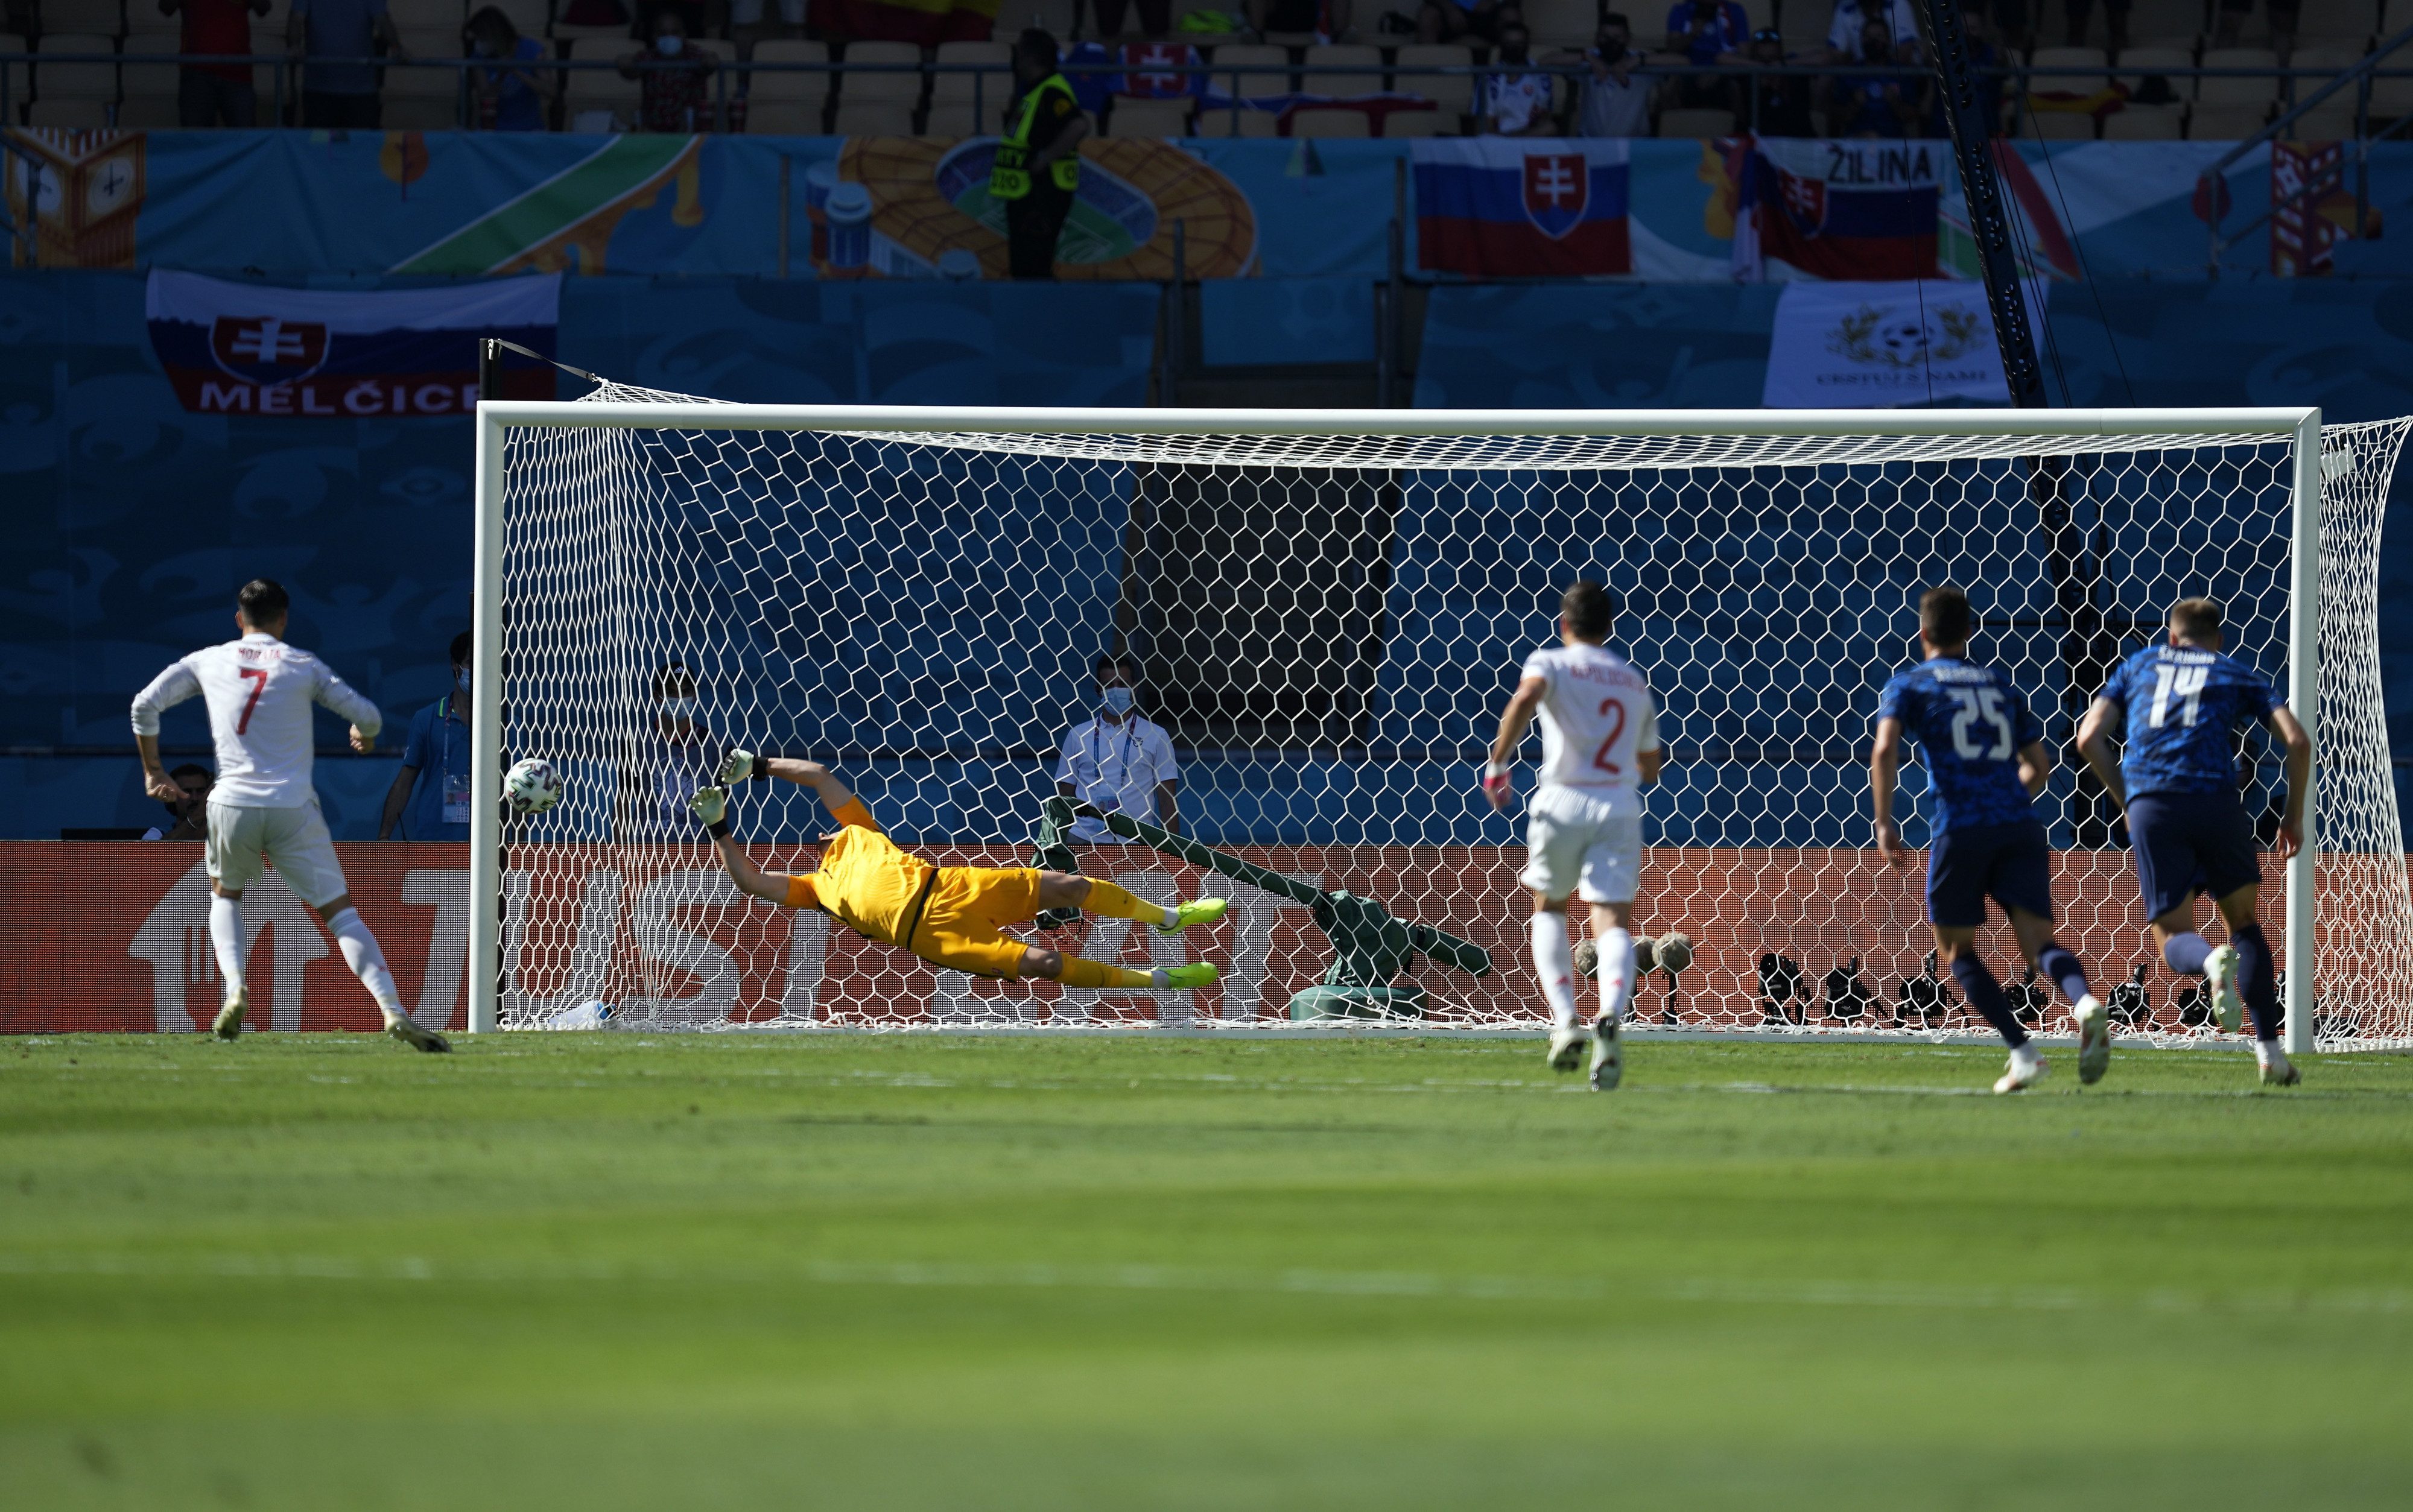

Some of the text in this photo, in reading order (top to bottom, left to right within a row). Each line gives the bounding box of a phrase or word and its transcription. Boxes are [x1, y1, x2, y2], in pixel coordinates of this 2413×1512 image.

[1828, 144, 1933, 183] ŽILINA
[236, 668, 268, 735] 7
[1945, 686, 2014, 762] 25
[2148, 663, 2210, 729] 14
[1593, 698, 1625, 775] 2
